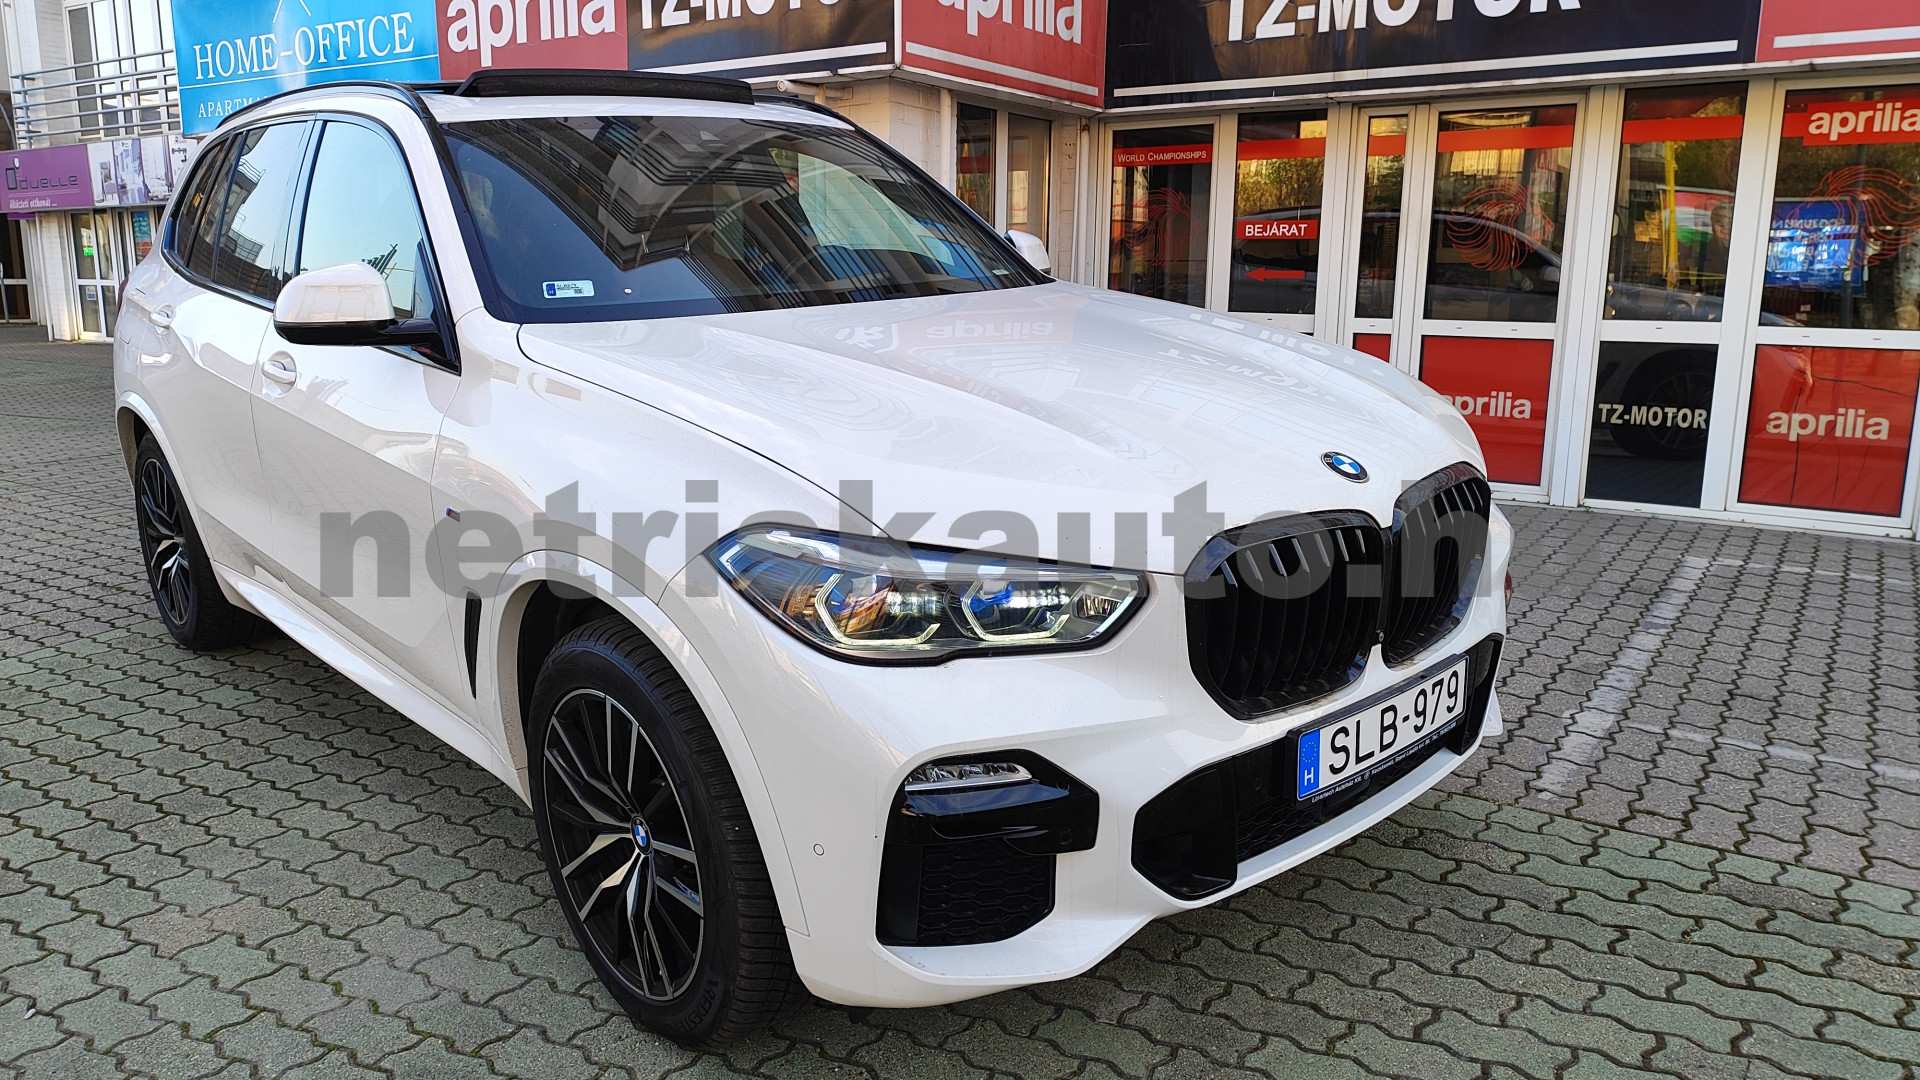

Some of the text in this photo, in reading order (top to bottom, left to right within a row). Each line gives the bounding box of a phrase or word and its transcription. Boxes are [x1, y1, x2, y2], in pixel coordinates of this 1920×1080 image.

[193, 11, 415, 80] HOME-OFFICE
[447, 0, 616, 68] aprilia
[198, 96, 268, 118] APARTM
[1808, 102, 1920, 141] aprilia
[1245, 221, 1308, 237] BEJÁRAT
[1598, 403, 1708, 429] TZ-MOTOR
[1766, 408, 1890, 441] aprilia
[1329, 670, 1460, 775] SLB-979
[1304, 766, 1314, 787] H
